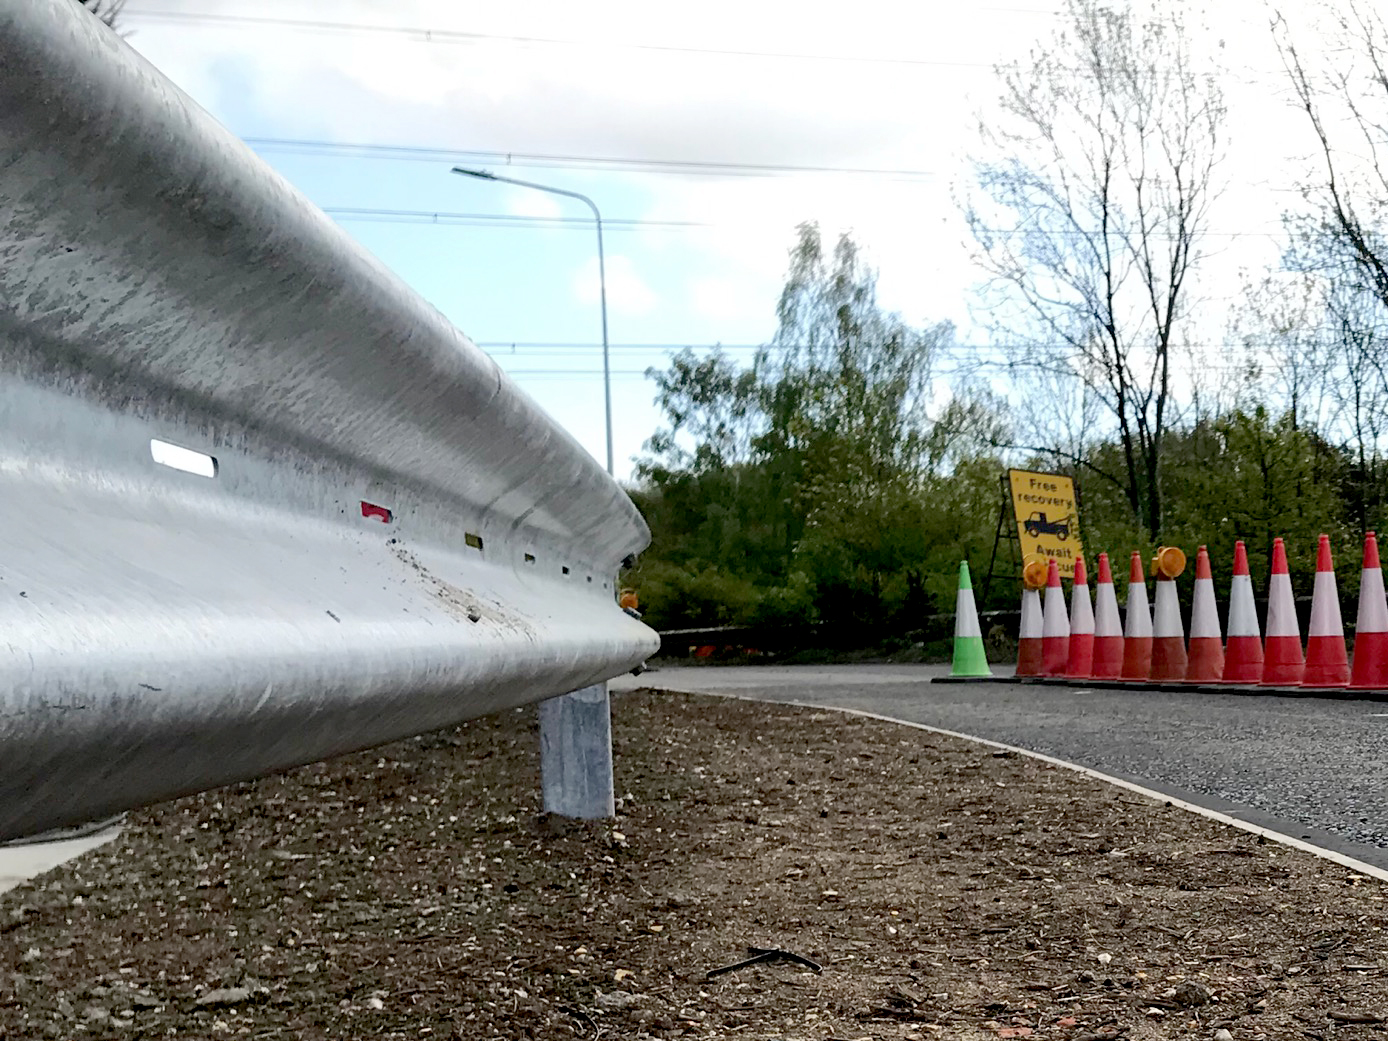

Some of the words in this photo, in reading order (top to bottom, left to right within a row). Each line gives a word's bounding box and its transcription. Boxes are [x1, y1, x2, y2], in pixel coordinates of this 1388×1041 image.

[1030, 478, 1057, 492] Free
[1018, 493, 1073, 509] recovery
[1037, 544, 1072, 559] Await
